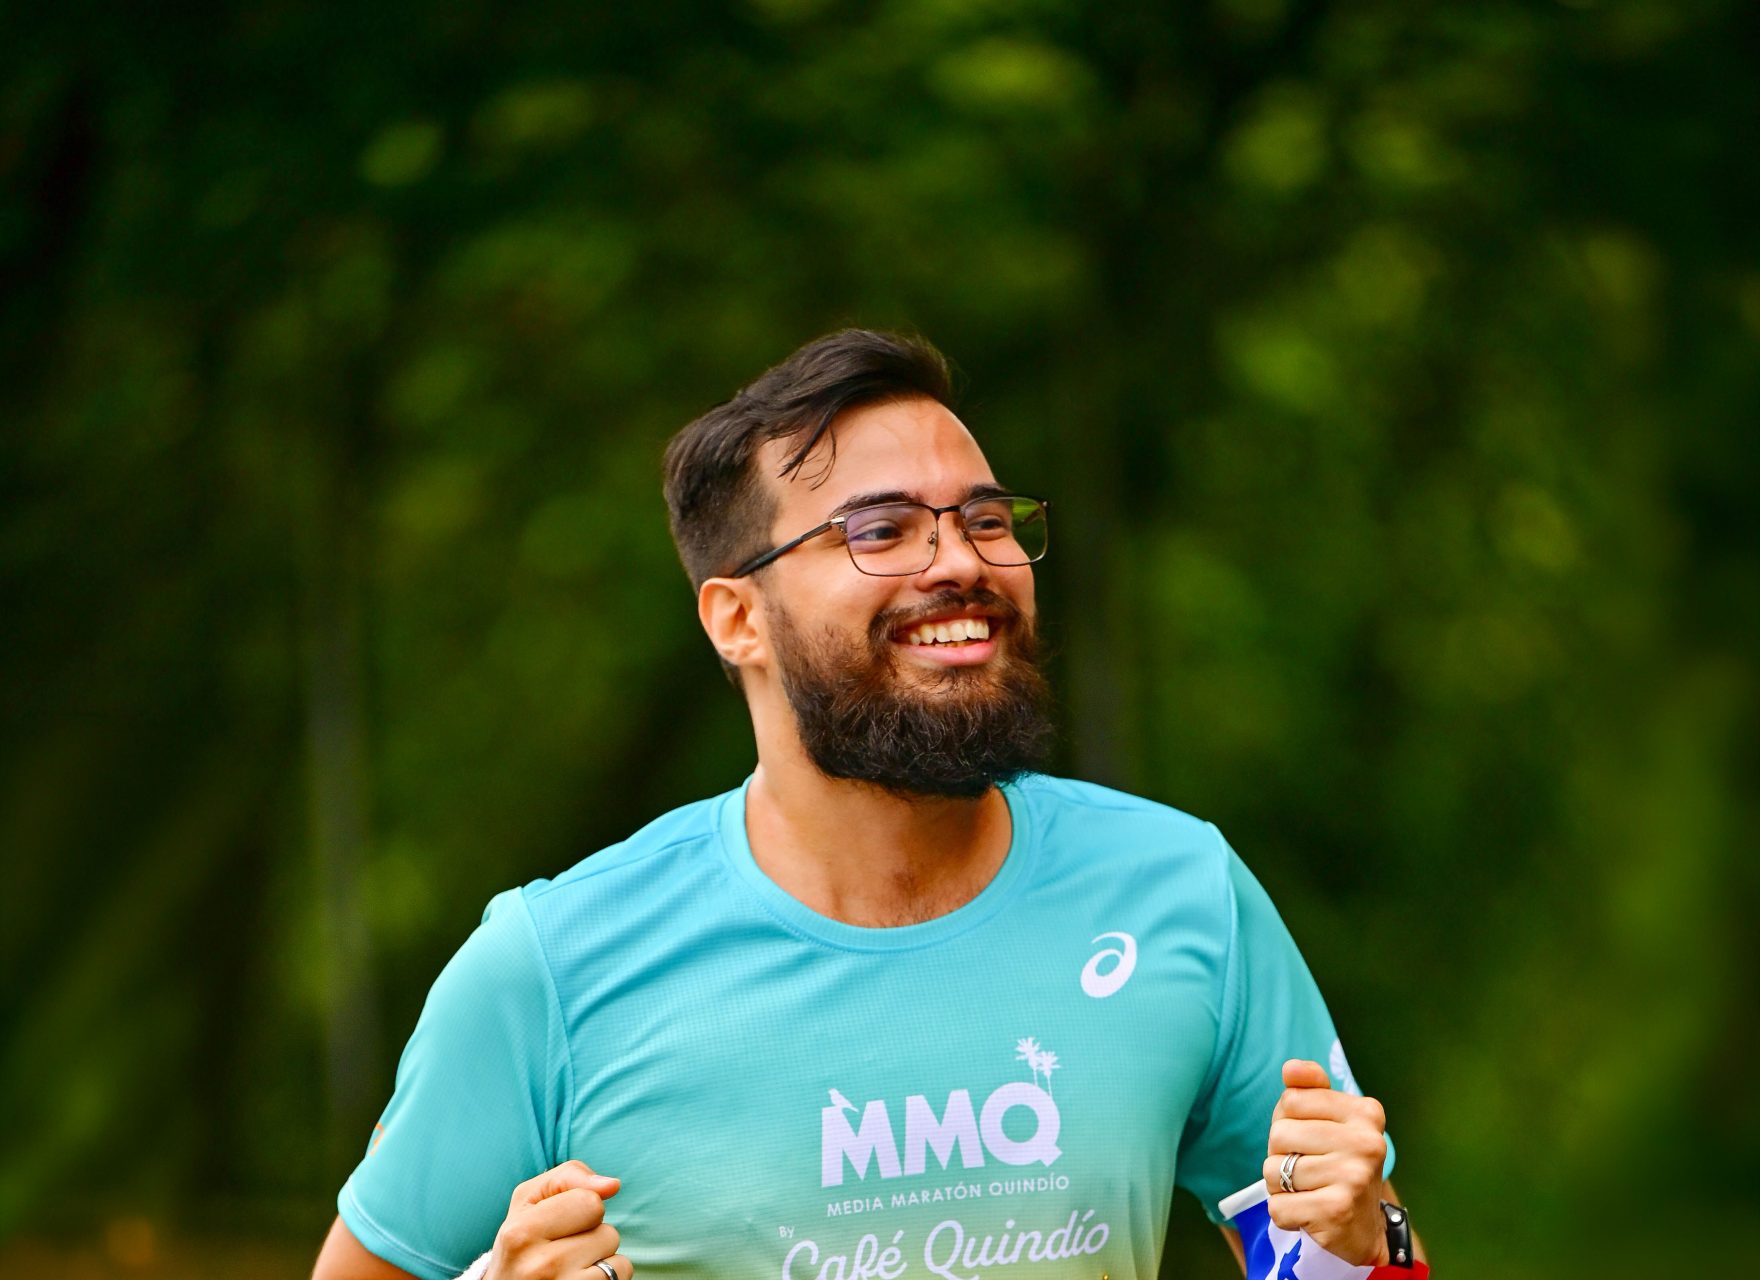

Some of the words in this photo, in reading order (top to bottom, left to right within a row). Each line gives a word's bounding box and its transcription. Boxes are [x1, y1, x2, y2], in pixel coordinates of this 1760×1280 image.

[821, 1082, 1063, 1188] MMQ
[827, 1197, 884, 1217] MEDIA
[891, 1181, 982, 1208] MARATÓN
[989, 1172, 1070, 1196] QUINDÍO
